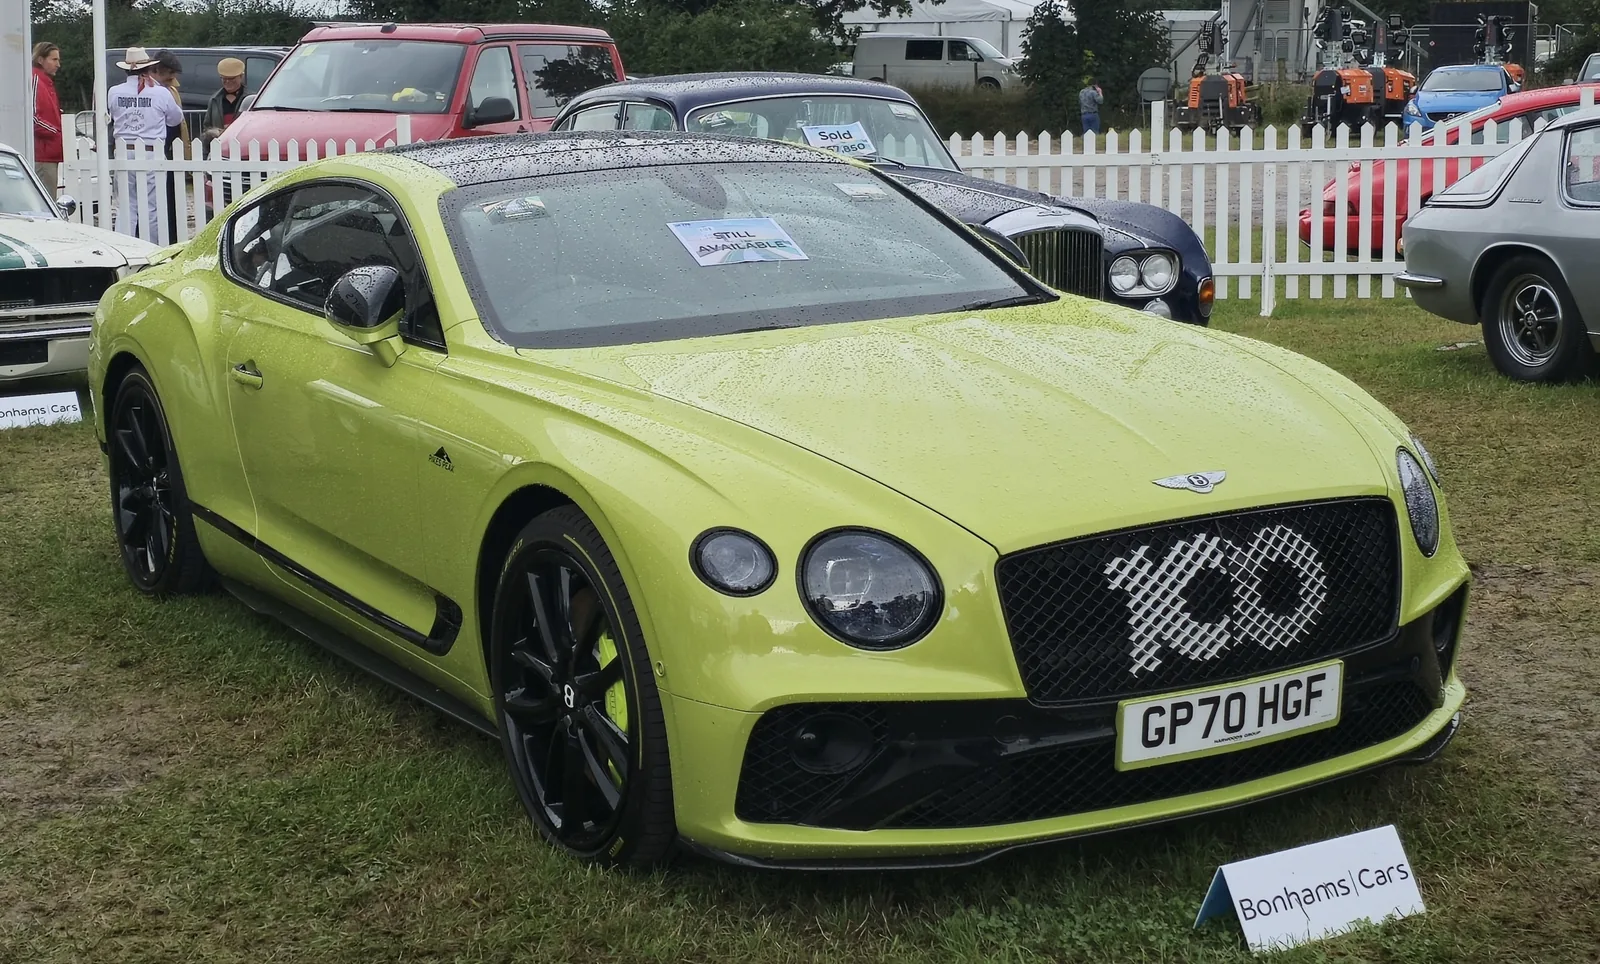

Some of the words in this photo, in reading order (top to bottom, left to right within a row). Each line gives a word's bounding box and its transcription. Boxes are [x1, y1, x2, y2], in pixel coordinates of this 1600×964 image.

[818, 130, 853, 141] Sold
[713, 231, 756, 241] STILL
[698, 240, 787, 254] AVAILABLE
[428, 454, 441, 467] PIKES
[1103, 525, 1328, 678] 100
[1141, 691, 1246, 749] GP70
[1257, 673, 1327, 728] HGF
